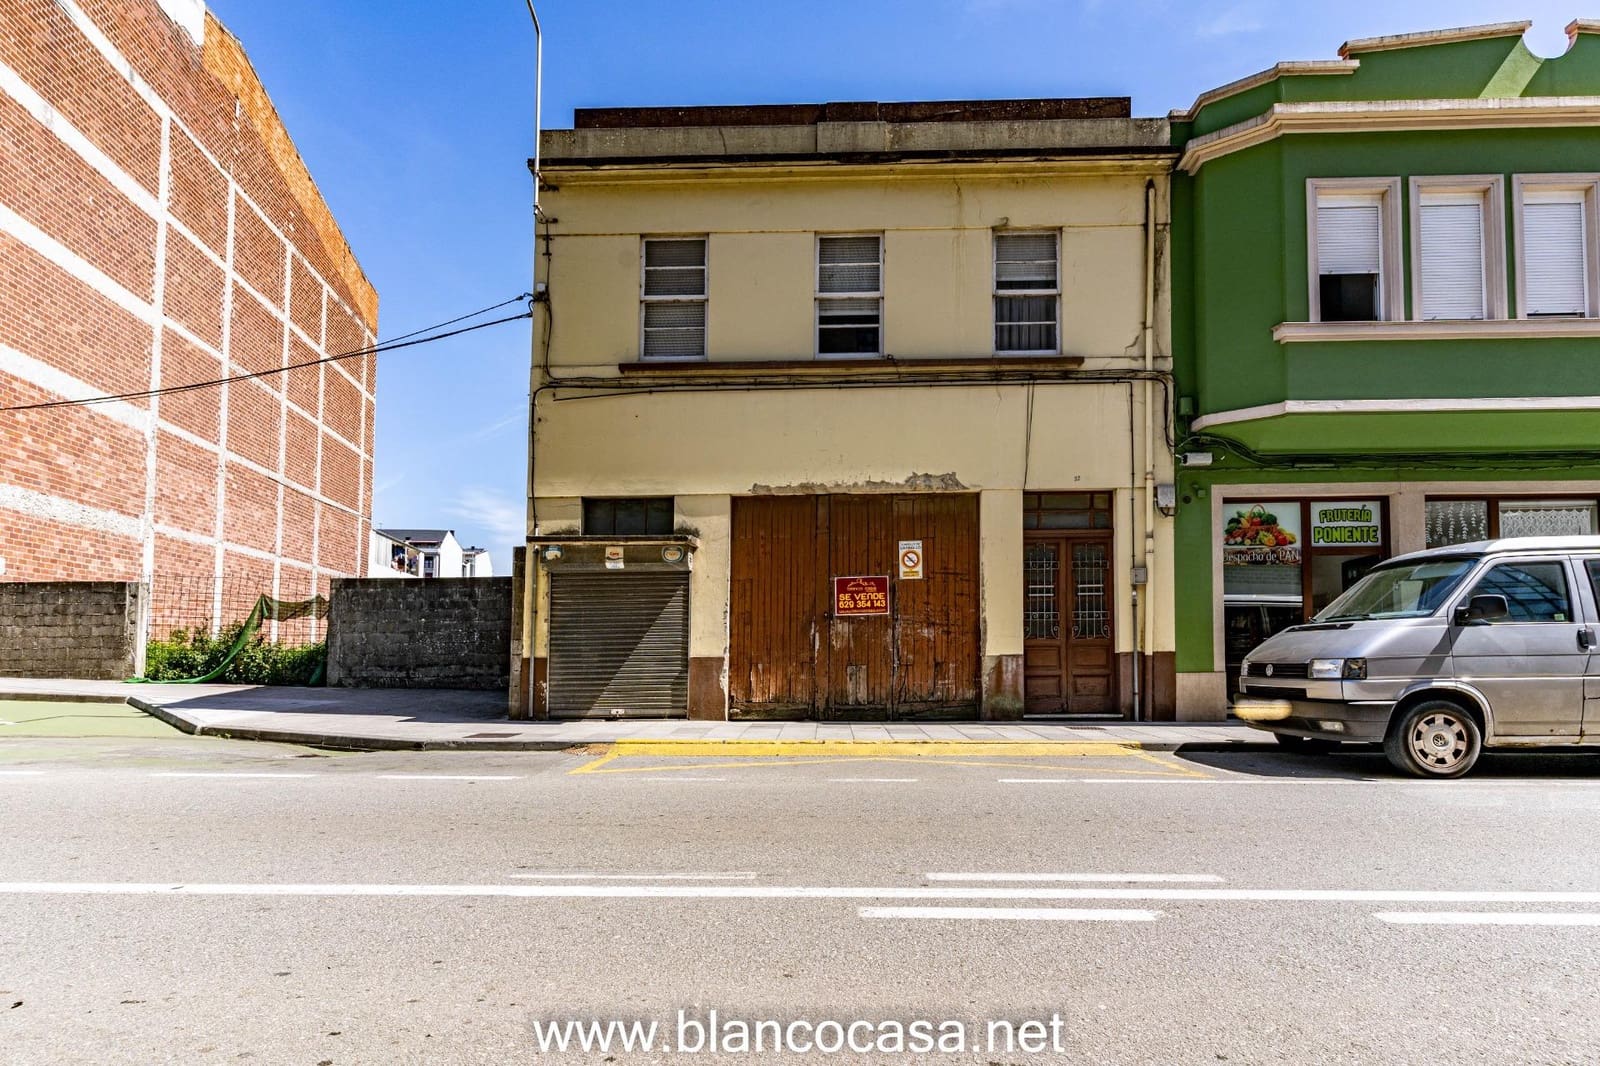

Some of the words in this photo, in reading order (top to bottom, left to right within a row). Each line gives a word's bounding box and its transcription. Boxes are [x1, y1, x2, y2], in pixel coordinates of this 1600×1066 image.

[1319, 504, 1372, 523] FRUTERÍA
[1313, 525, 1379, 543] PONIENTE
[1266, 551, 1278, 561] de
[1280, 549, 1299, 561] PAN
[839, 593, 852, 601] SE
[854, 592, 886, 600] VENDE
[839, 600, 854, 608] 629
[856, 600, 871, 608] 354
